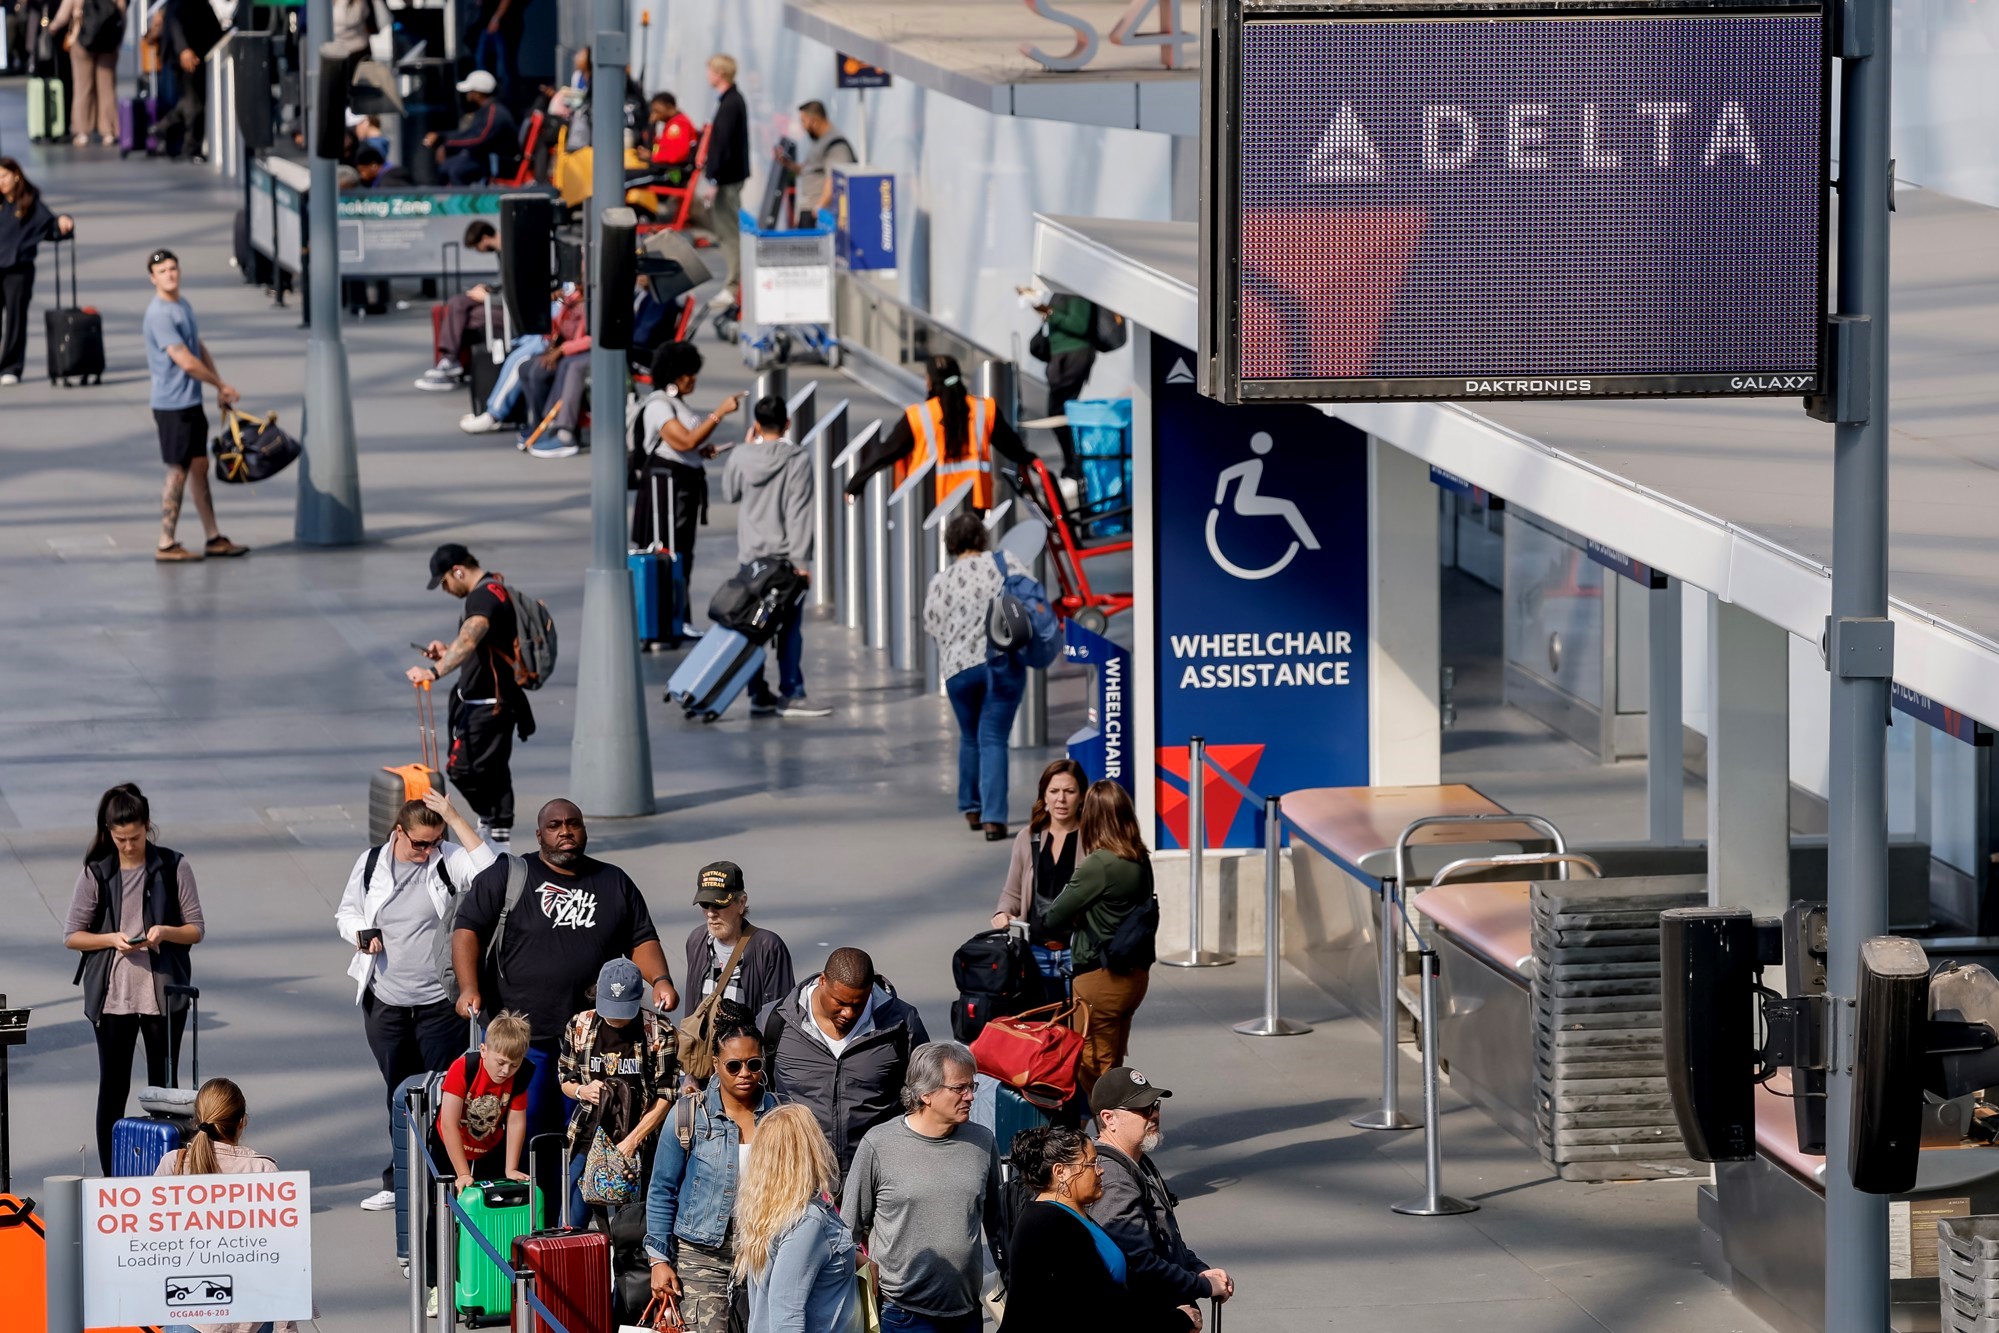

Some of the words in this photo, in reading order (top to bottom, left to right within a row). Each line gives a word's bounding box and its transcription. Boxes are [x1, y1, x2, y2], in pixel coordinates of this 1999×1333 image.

[1422, 101, 1761, 169] DELTA
[337, 199, 389, 217] moking
[392, 198, 432, 215] Zone
[1466, 379, 1591, 392] DAKTRONICS
[1170, 631, 1352, 658] WHEELCHAIR
[1180, 662, 1350, 689] ASSISTANCE
[1105, 657, 1122, 779] WHEELCHAIR
[702, 870, 727, 878] VIETNAM
[99, 1187, 141, 1208] NO
[152, 1181, 296, 1206] STOPPING
[97, 1213, 138, 1234] OR
[149, 1208, 298, 1232] STANDING
[130, 1238, 184, 1252] Except
[190, 1237, 211, 1250] for
[217, 1236, 268, 1248] Active
[118, 1254, 181, 1267] Loading
[200, 1250, 280, 1264] Unloading
[170, 1309, 230, 1318] OCGA40-6-203
